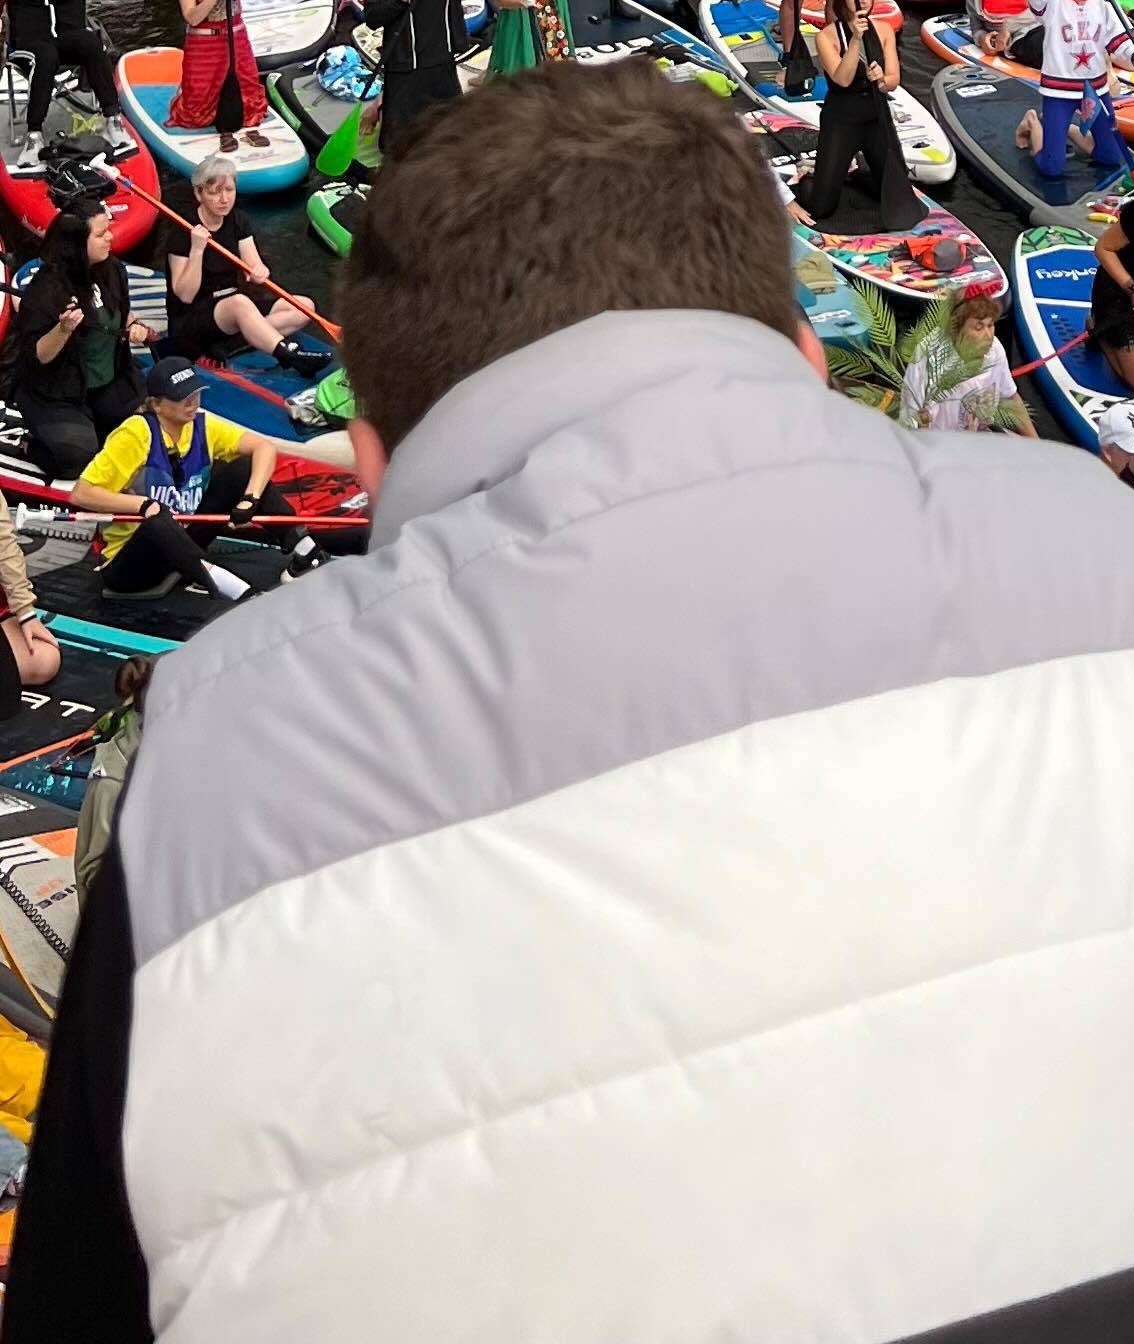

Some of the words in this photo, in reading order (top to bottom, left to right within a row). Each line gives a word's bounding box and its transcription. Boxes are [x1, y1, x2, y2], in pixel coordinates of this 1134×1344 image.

[1061, 21, 1102, 45] СКА
[1035, 265, 1099, 282] onkey
[150, 485, 203, 515] VICRIA
